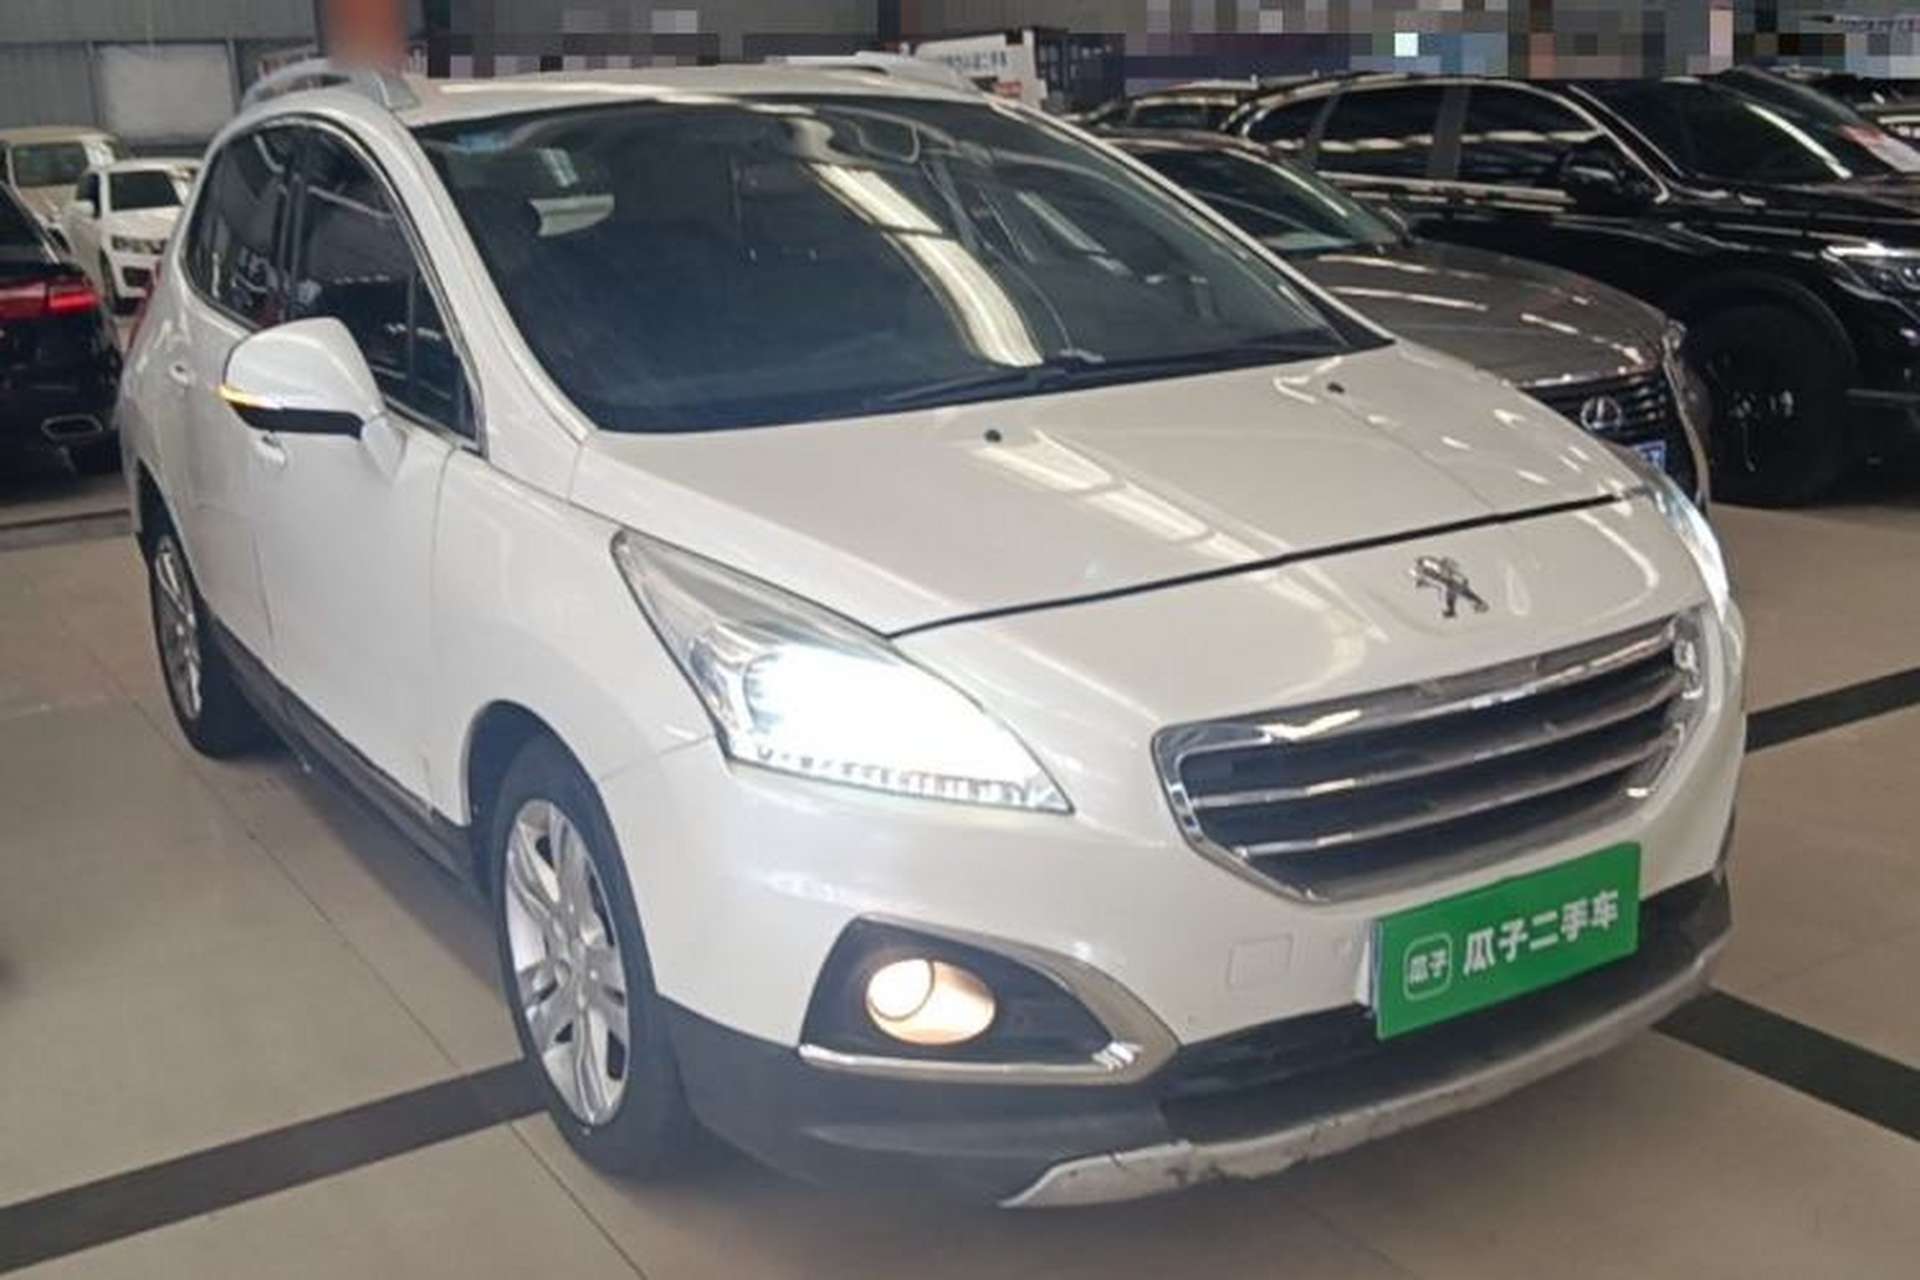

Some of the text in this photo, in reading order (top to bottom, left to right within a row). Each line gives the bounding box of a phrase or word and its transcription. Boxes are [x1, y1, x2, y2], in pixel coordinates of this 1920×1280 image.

[1463, 890, 1619, 976] 瓜子二手车
